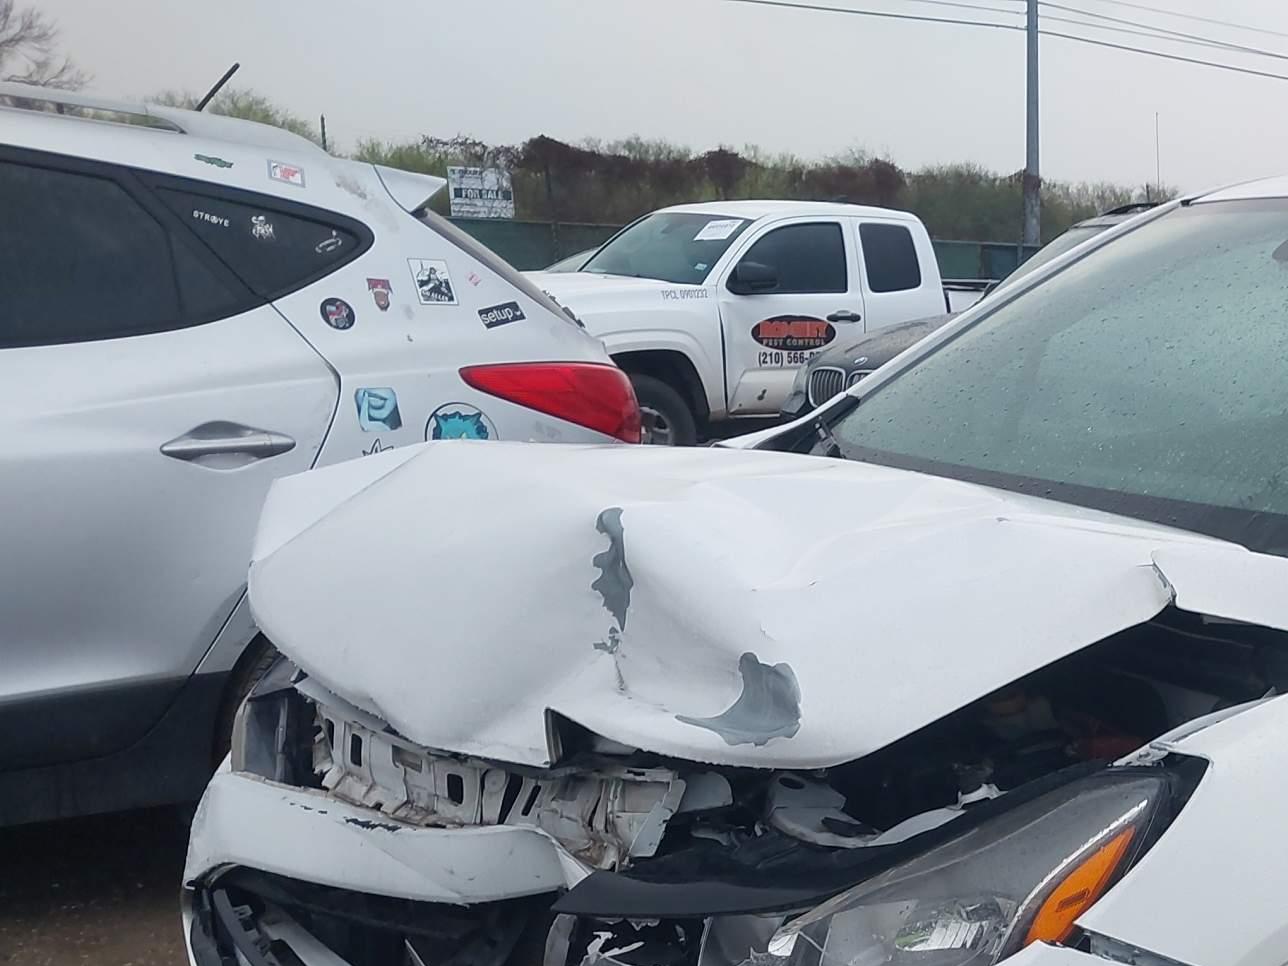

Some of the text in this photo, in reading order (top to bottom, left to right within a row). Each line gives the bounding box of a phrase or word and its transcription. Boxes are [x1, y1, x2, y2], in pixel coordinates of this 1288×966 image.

[462, 189, 480, 199] FOR
[480, 306, 514, 325] setup
[762, 338, 826, 347] PEST CONTROL
[758, 351, 784, 367] (210)
